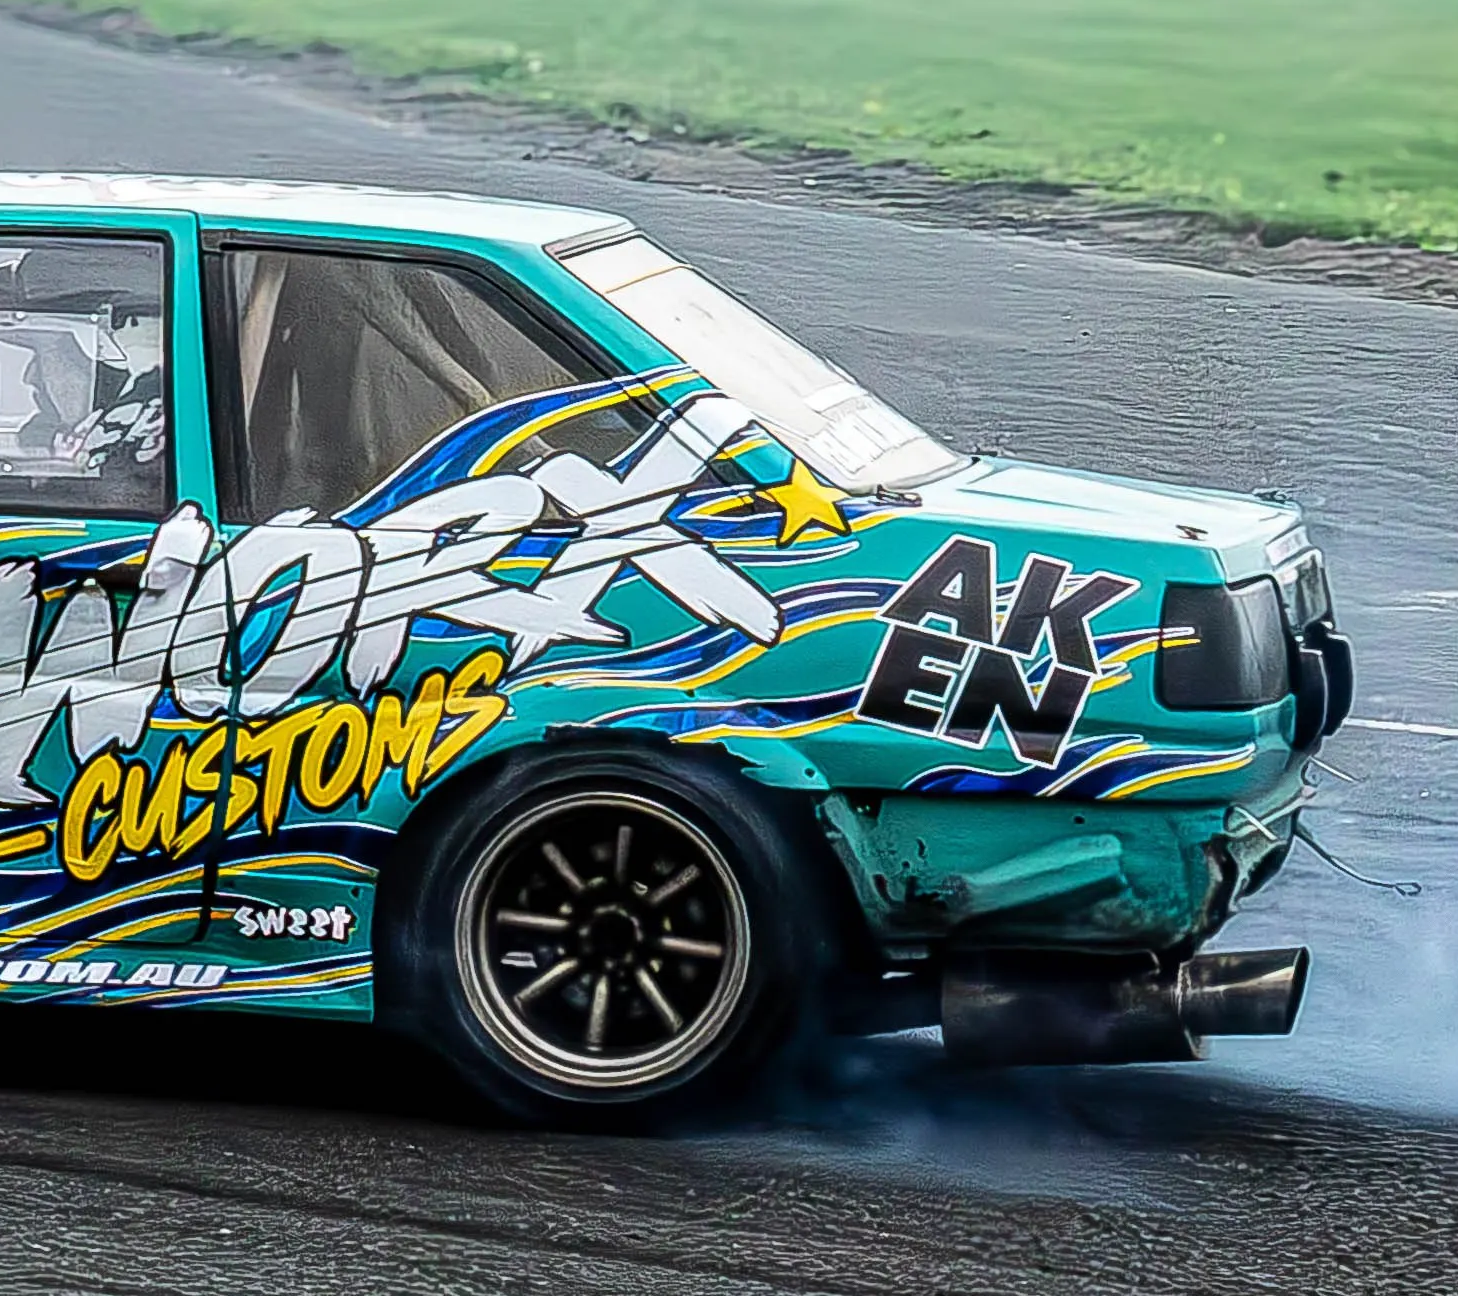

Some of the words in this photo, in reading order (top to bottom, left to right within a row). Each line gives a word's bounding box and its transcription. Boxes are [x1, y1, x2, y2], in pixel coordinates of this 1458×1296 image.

[876, 535, 1139, 674] AK
[61, 651, 510, 881] CUSTOMS
[857, 622, 1094, 768] EN
